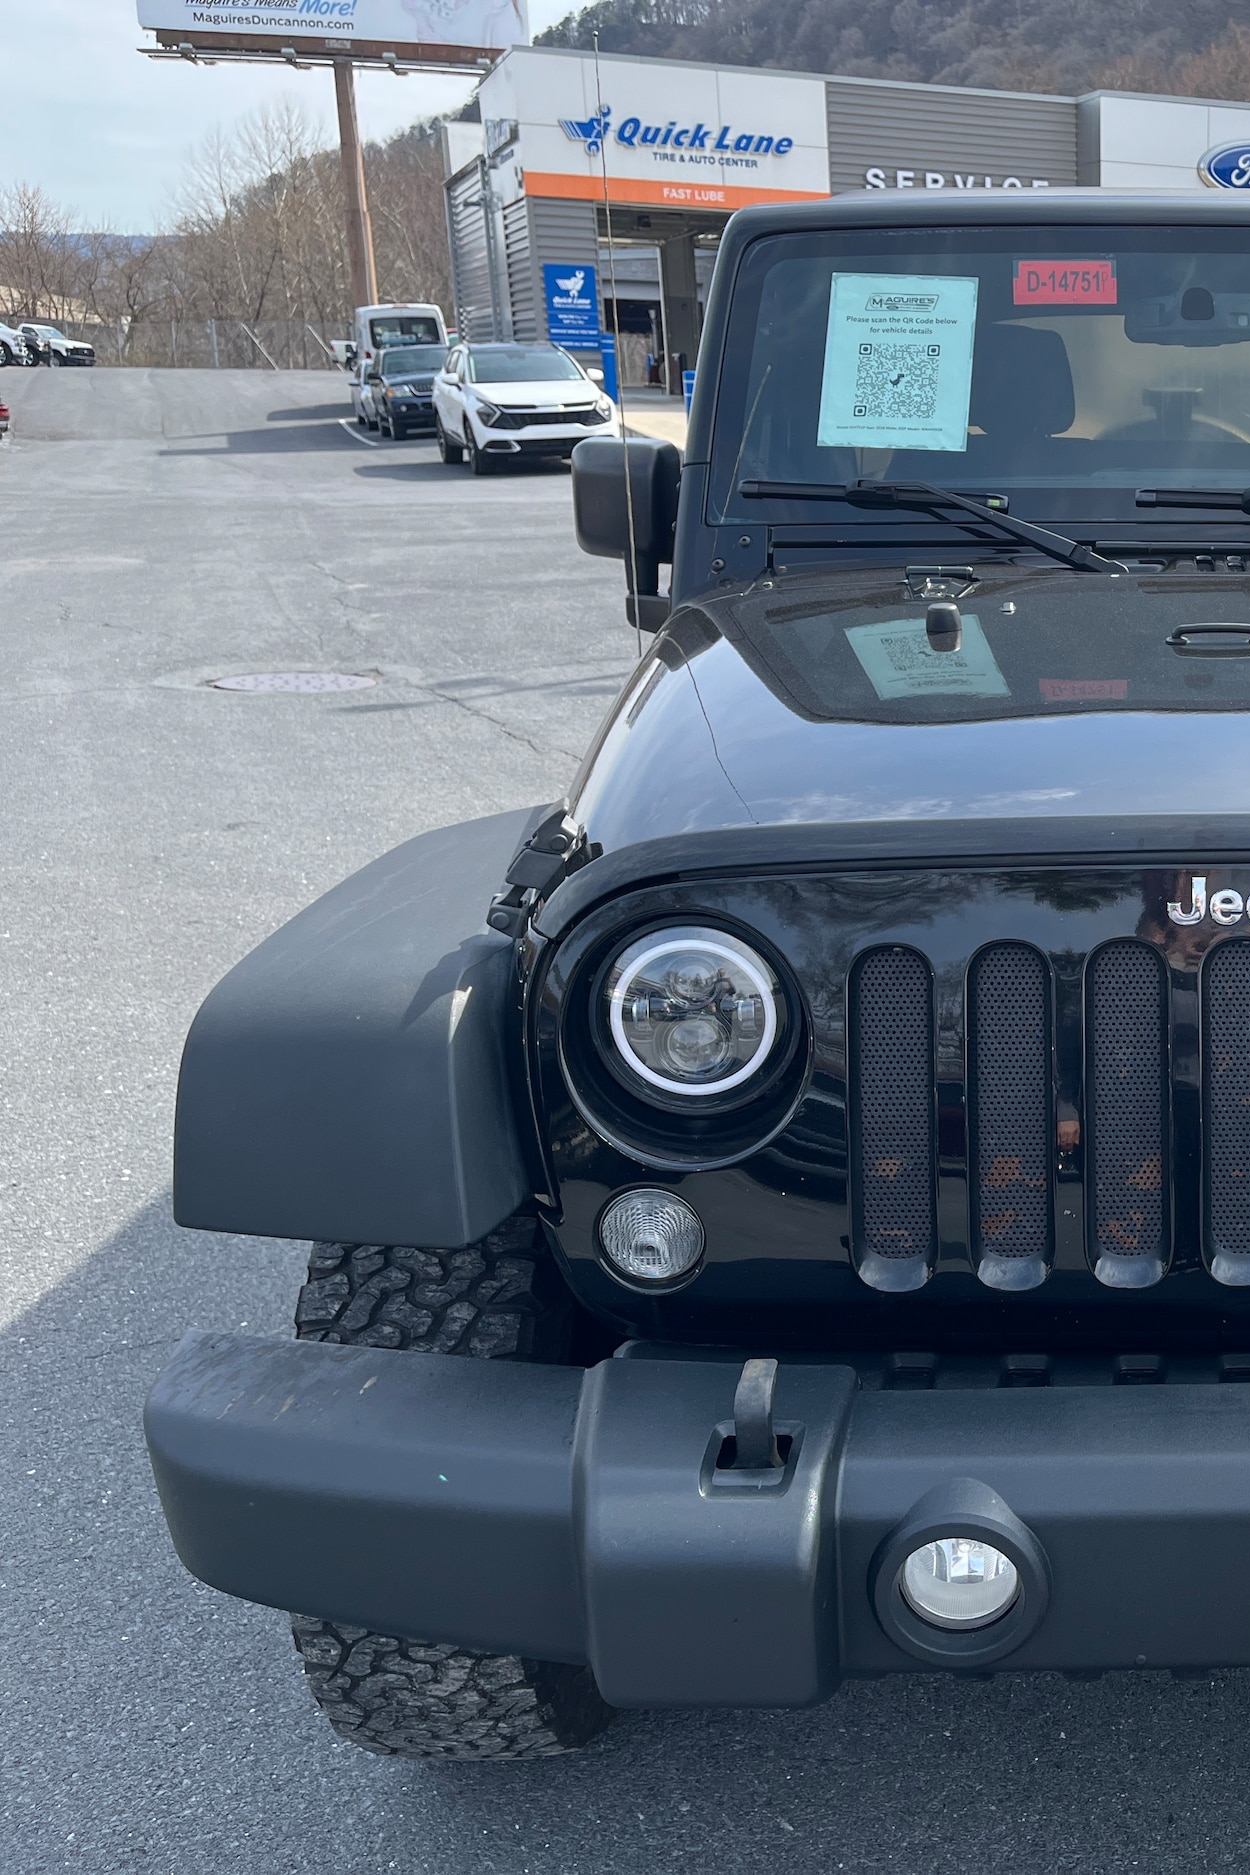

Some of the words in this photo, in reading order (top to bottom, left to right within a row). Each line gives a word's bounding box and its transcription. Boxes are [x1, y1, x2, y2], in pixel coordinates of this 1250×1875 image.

[186, 0, 250, 9] aguires
[299, 0, 357, 16] More!
[193, 12, 354, 30] MaguiresDuncannon.com
[617, 117, 711, 148] Quick
[714, 126, 793, 155] Lane
[652, 152, 676, 163] TIRE
[679, 154, 686, 163] &
[688, 155, 715, 166] AUTO
[718, 157, 758, 169] CENTER
[663, 187, 692, 199] FAST
[695, 190, 725, 202] LUBE
[846, 316, 870, 324] Please
[902, 317, 914, 325] QR
[915, 317, 934, 325] Code
[909, 327, 933, 335] details
